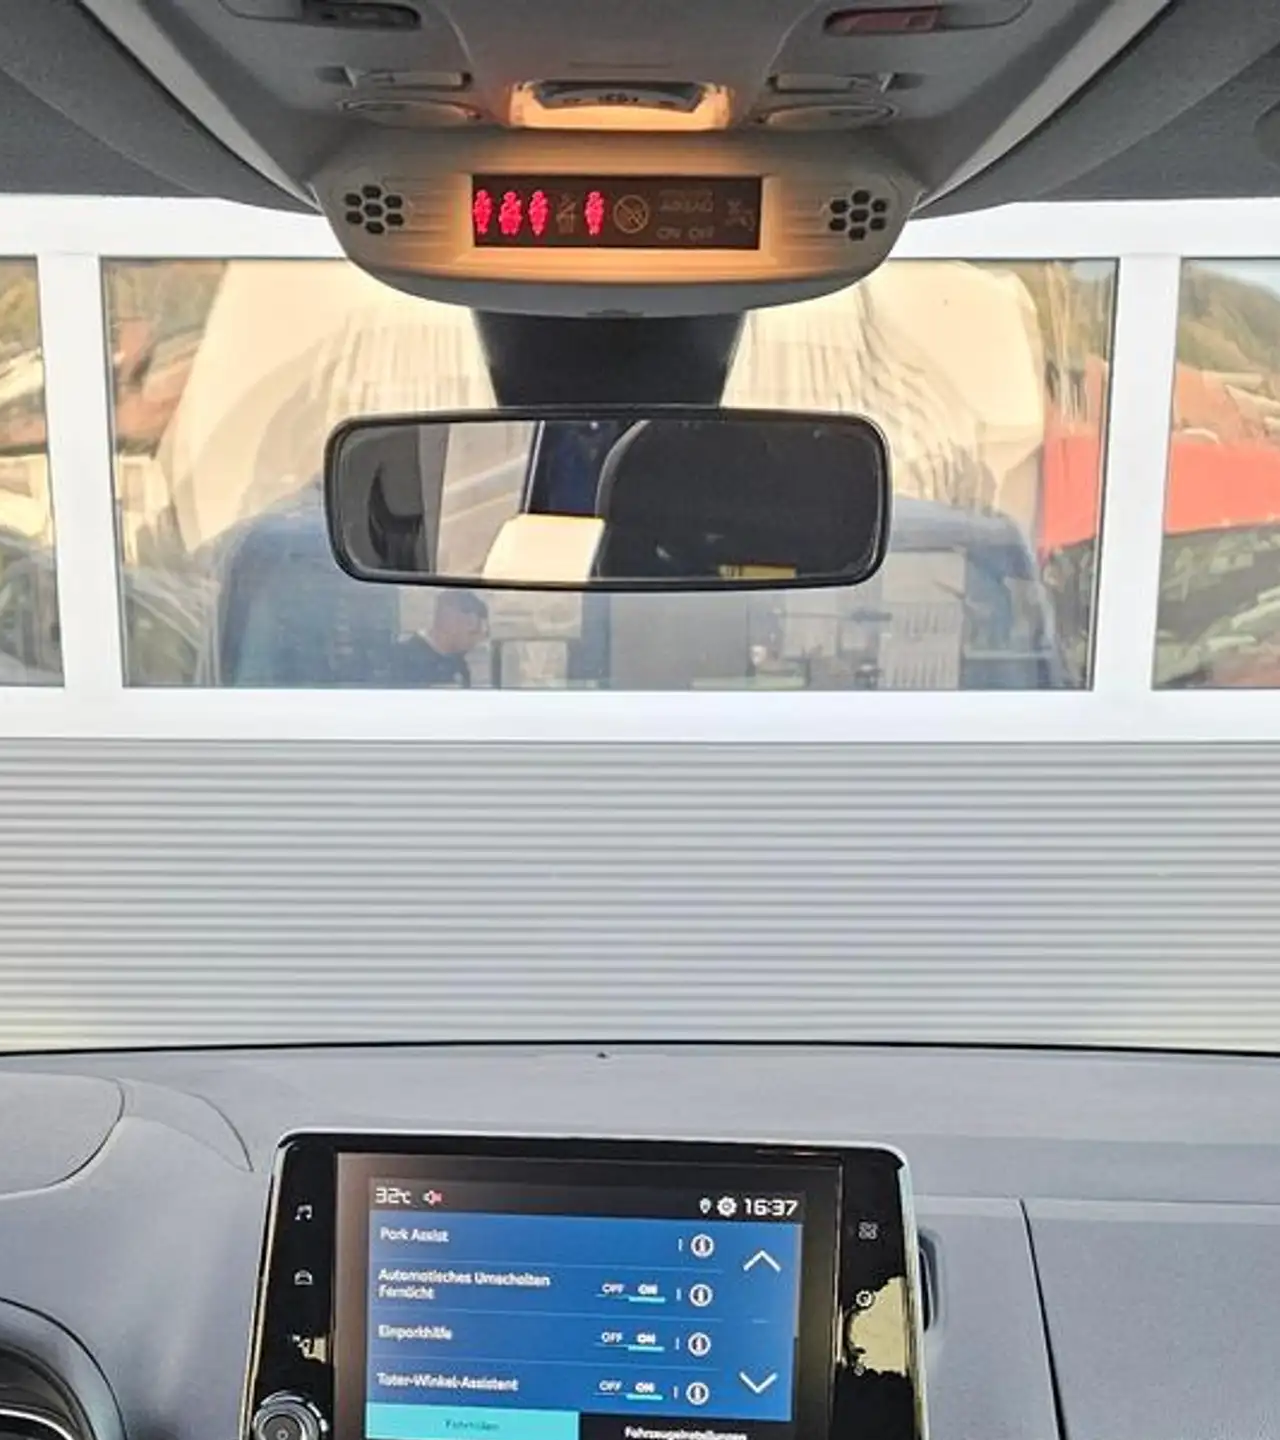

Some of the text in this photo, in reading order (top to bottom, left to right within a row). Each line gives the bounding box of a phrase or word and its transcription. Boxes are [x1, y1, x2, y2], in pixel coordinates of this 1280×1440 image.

[744, 1198, 798, 1216] 16:37
[380, 1227, 449, 1242] Park Assist
[378, 1268, 551, 1287] Automatisches Umschalten
[378, 1285, 435, 1299] Fernlicht
[601, 1283, 658, 1295] OFF ON
[601, 1332, 656, 1344] OFF ON
[376, 1373, 519, 1391] Toter-Winkel-Assistent
[599, 1380, 654, 1393] OFF ON
